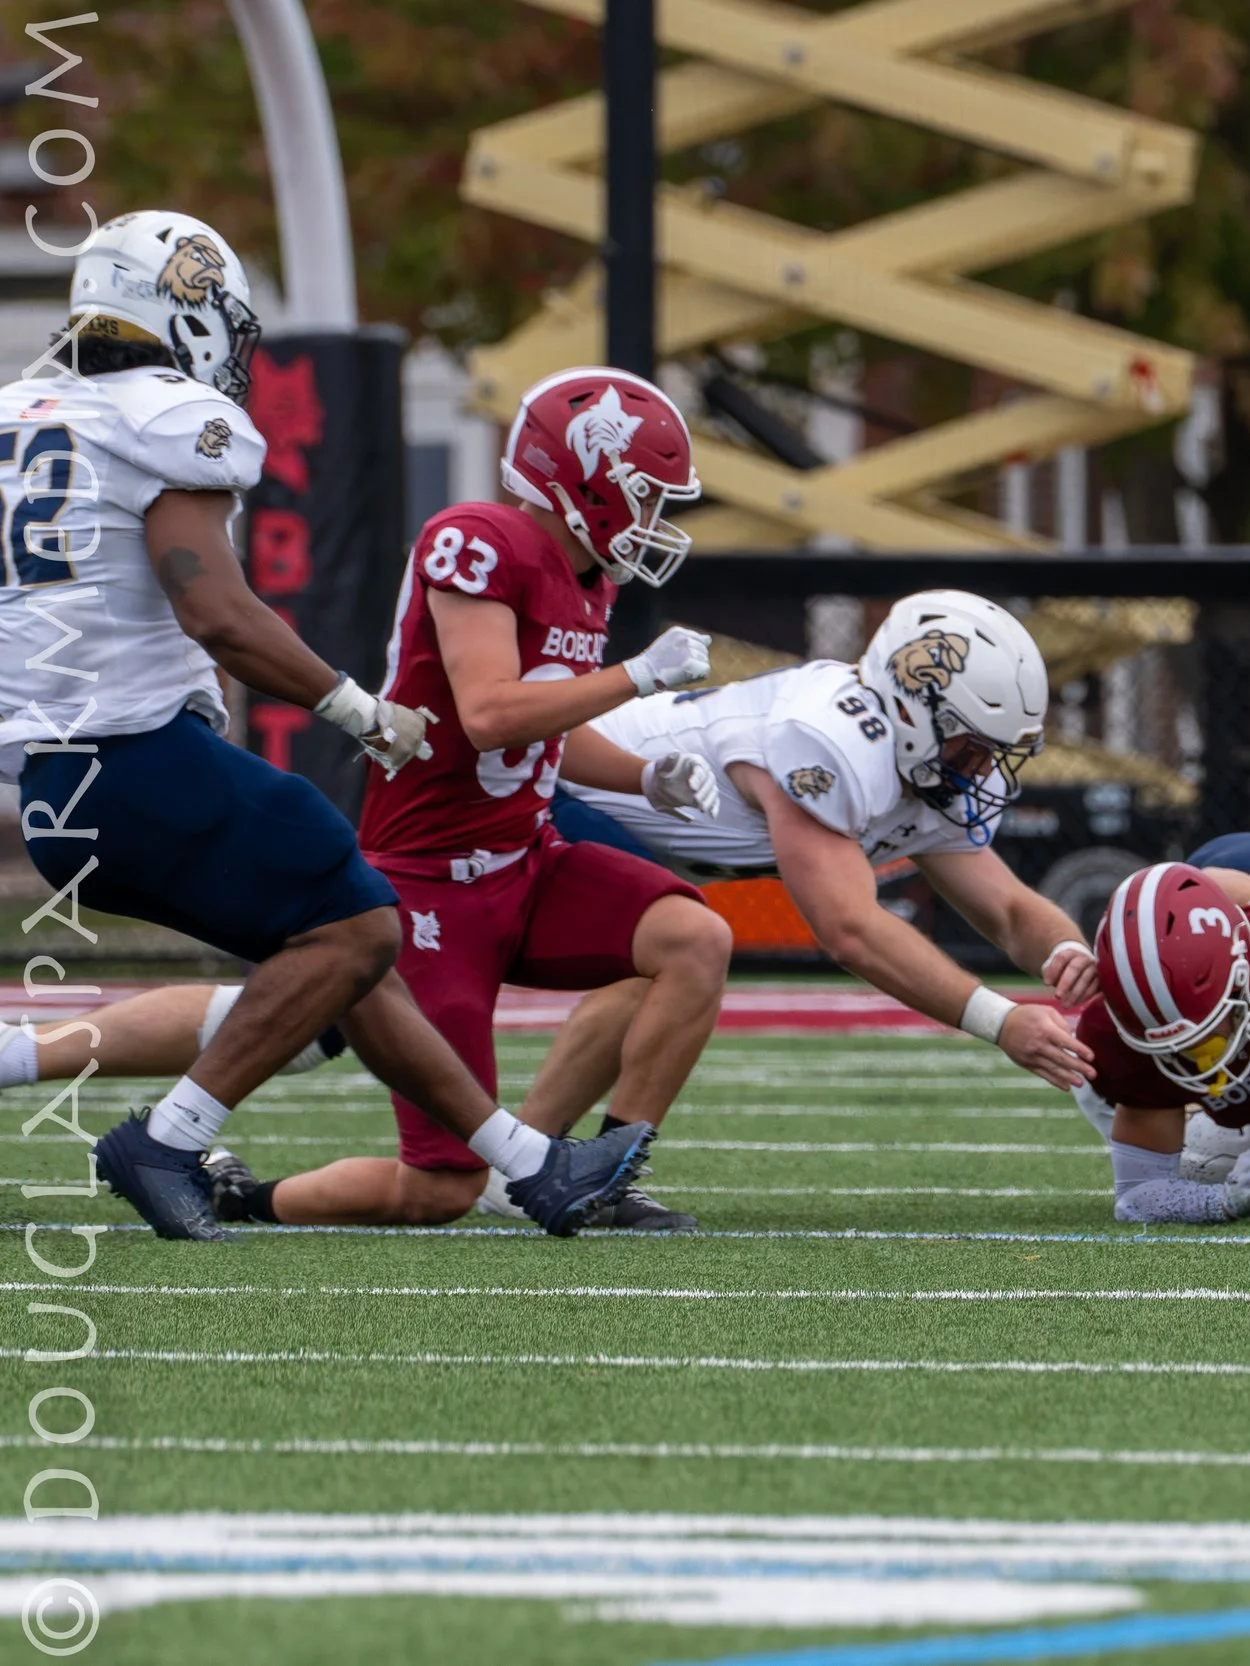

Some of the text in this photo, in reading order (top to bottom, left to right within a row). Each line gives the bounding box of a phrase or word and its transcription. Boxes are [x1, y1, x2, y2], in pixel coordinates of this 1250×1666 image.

[423, 526, 499, 595] 83
[836, 695, 888, 744] 98
[1188, 907, 1232, 938] 3
